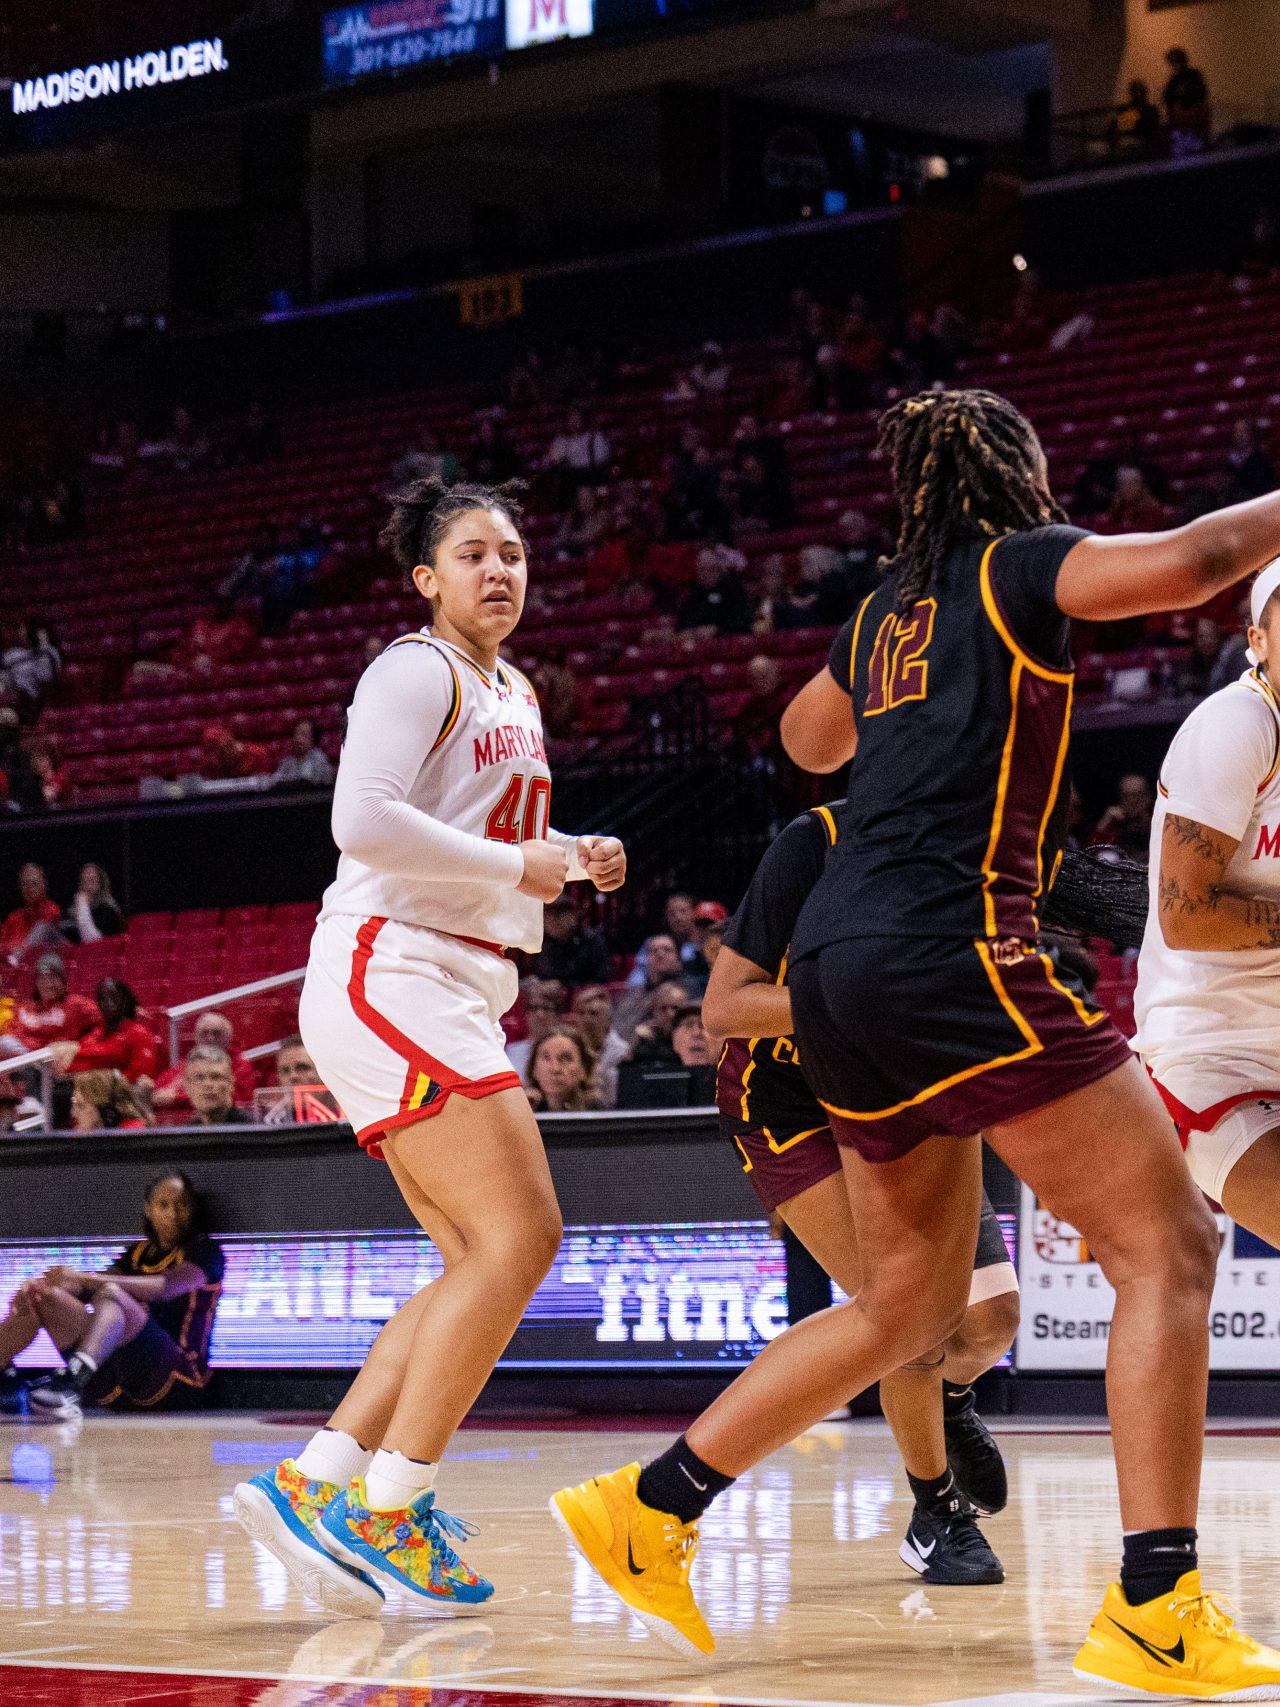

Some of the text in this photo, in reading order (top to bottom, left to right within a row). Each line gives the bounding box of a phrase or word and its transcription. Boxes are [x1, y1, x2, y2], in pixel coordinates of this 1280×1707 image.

[12, 36, 230, 115] MADISON HOLDEN.
[863, 596, 938, 716] 12
[484, 773, 552, 845] 40
